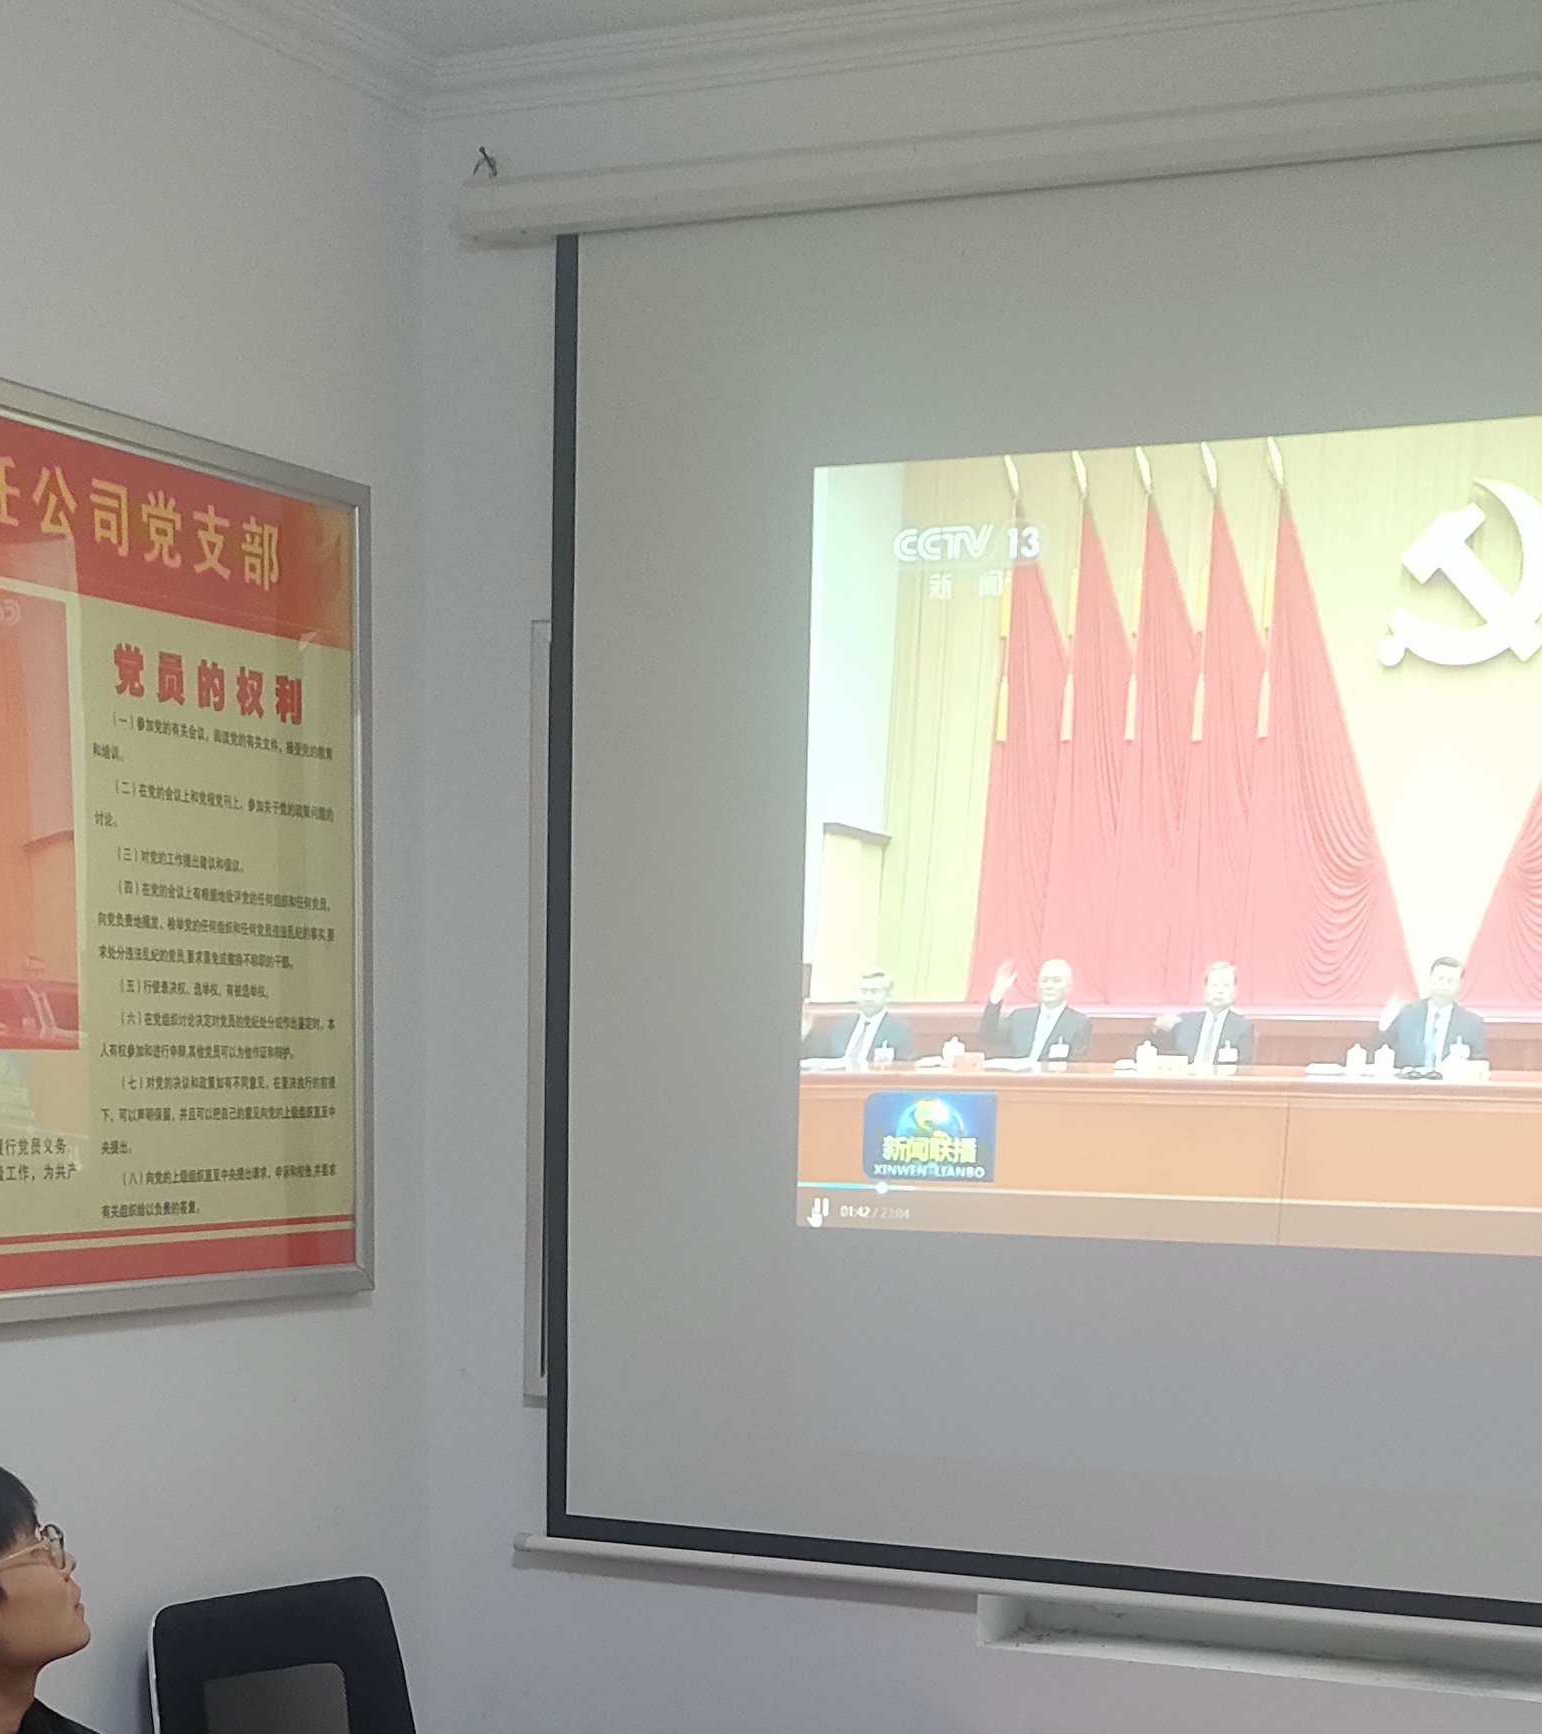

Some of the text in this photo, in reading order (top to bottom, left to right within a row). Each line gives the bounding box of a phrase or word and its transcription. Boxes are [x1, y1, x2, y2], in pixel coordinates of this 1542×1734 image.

[893, 524, 1040, 561] CCTV 13
[113, 642, 302, 725] 党员的权利
[882, 1135, 978, 1163] 新闻联播
[873, 1164, 928, 1177] XINWEN
